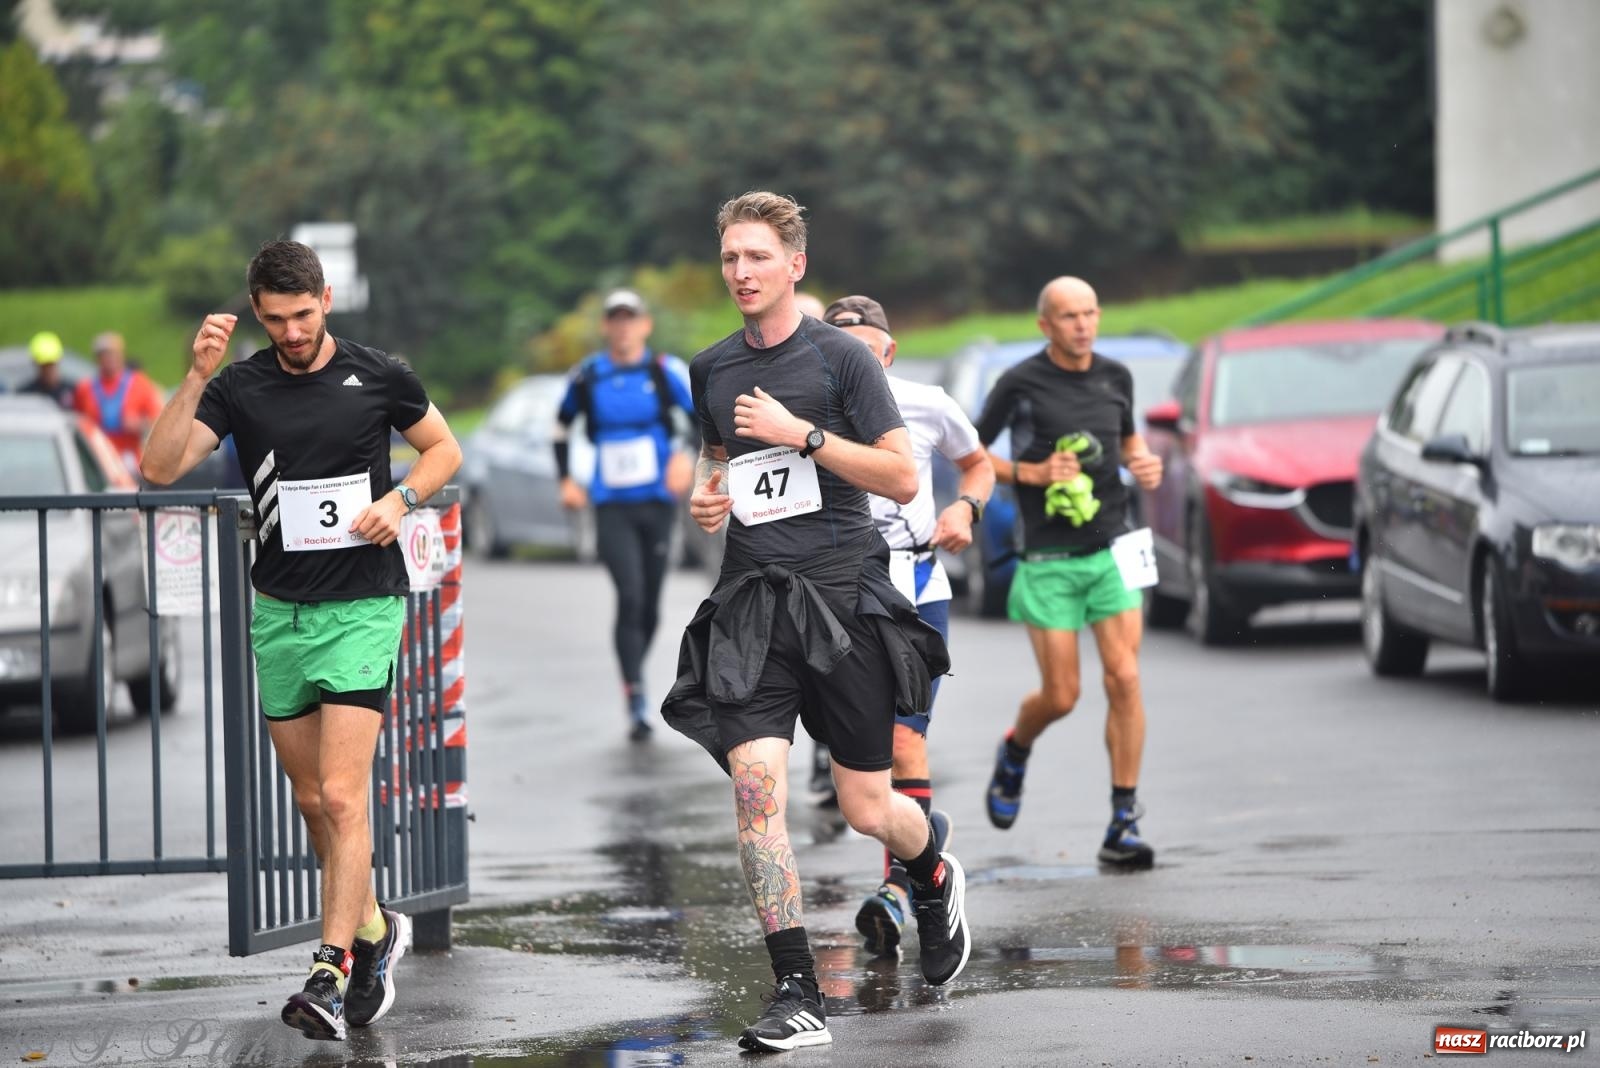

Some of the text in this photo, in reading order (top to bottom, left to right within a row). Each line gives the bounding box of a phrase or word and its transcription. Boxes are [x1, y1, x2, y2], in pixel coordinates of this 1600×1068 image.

[754, 467, 790, 499] 47
[319, 500, 339, 528] 3
[753, 507, 787, 519] Racibórz
[304, 535, 342, 546] Racibórz
